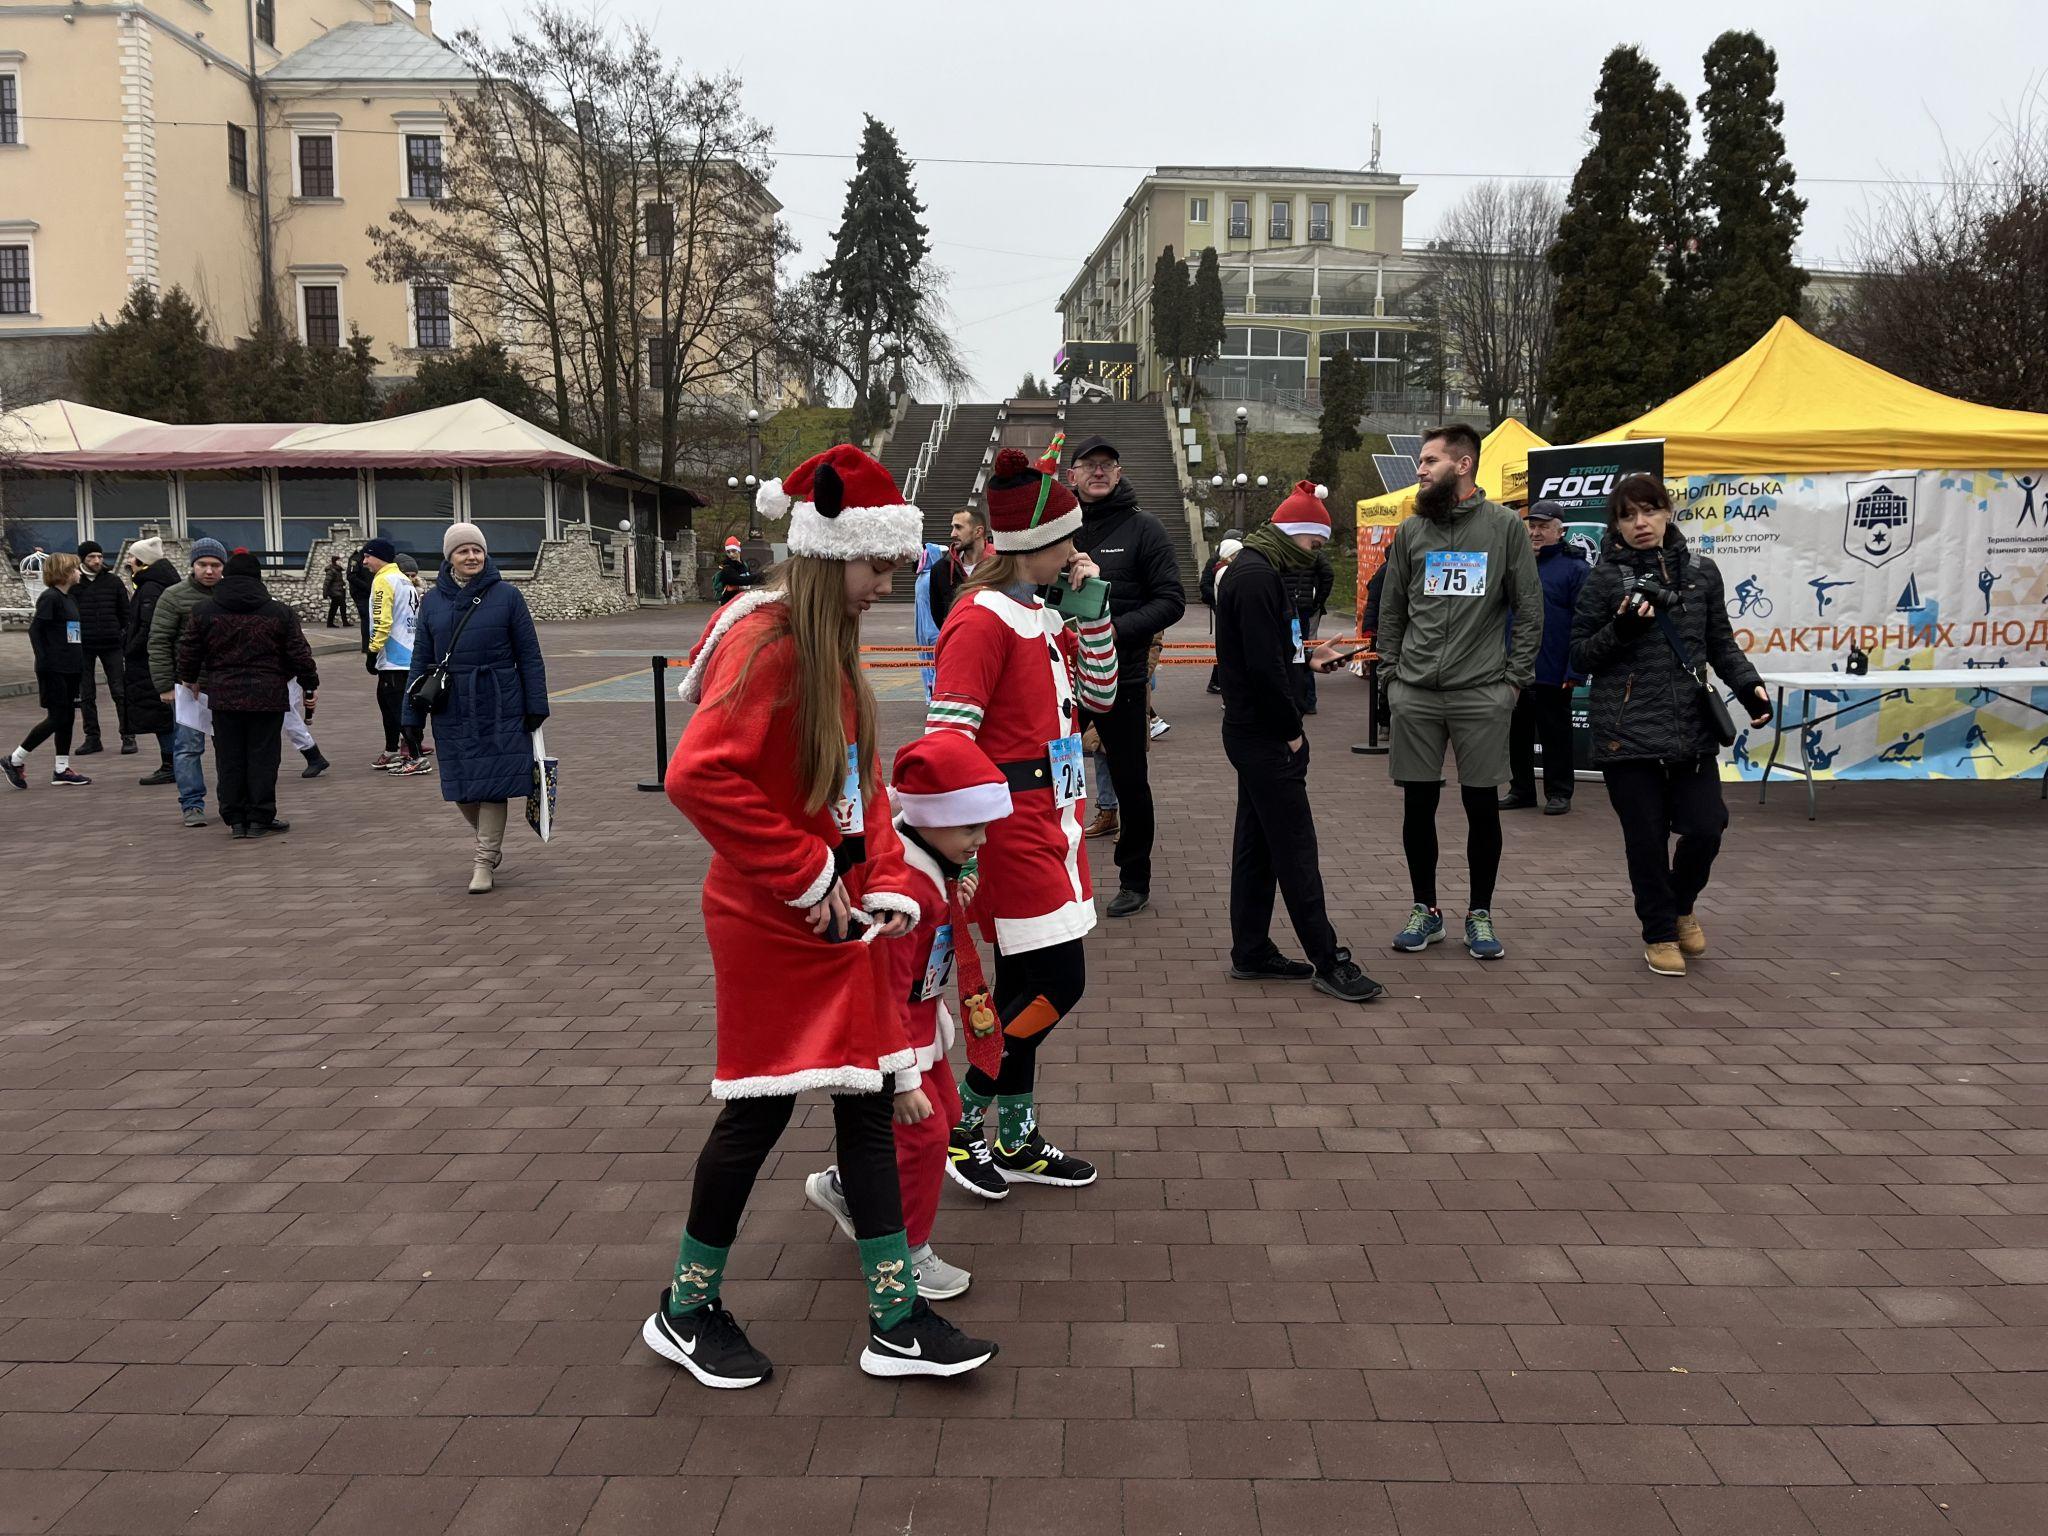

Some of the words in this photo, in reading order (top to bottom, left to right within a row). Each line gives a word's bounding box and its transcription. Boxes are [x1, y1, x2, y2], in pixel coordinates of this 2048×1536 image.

[1569, 464, 1620, 476] STRONG
[1539, 472, 1651, 499] FOCU
[1667, 482, 1783, 500] РНОПІЛЬСЬКА
[1672, 506, 1718, 522] ІСЬКА
[1723, 504, 1770, 521] РАДА
[1698, 534, 1743, 544] РОЗВИТКУ
[1745, 533, 1781, 542] СПОРТУ
[1717, 545, 1761, 555] КУЛЬТУРИ
[1442, 568, 1467, 591] 75
[1733, 628, 1755, 652] О
[1765, 622, 1956, 655] АКТИВНИХ
